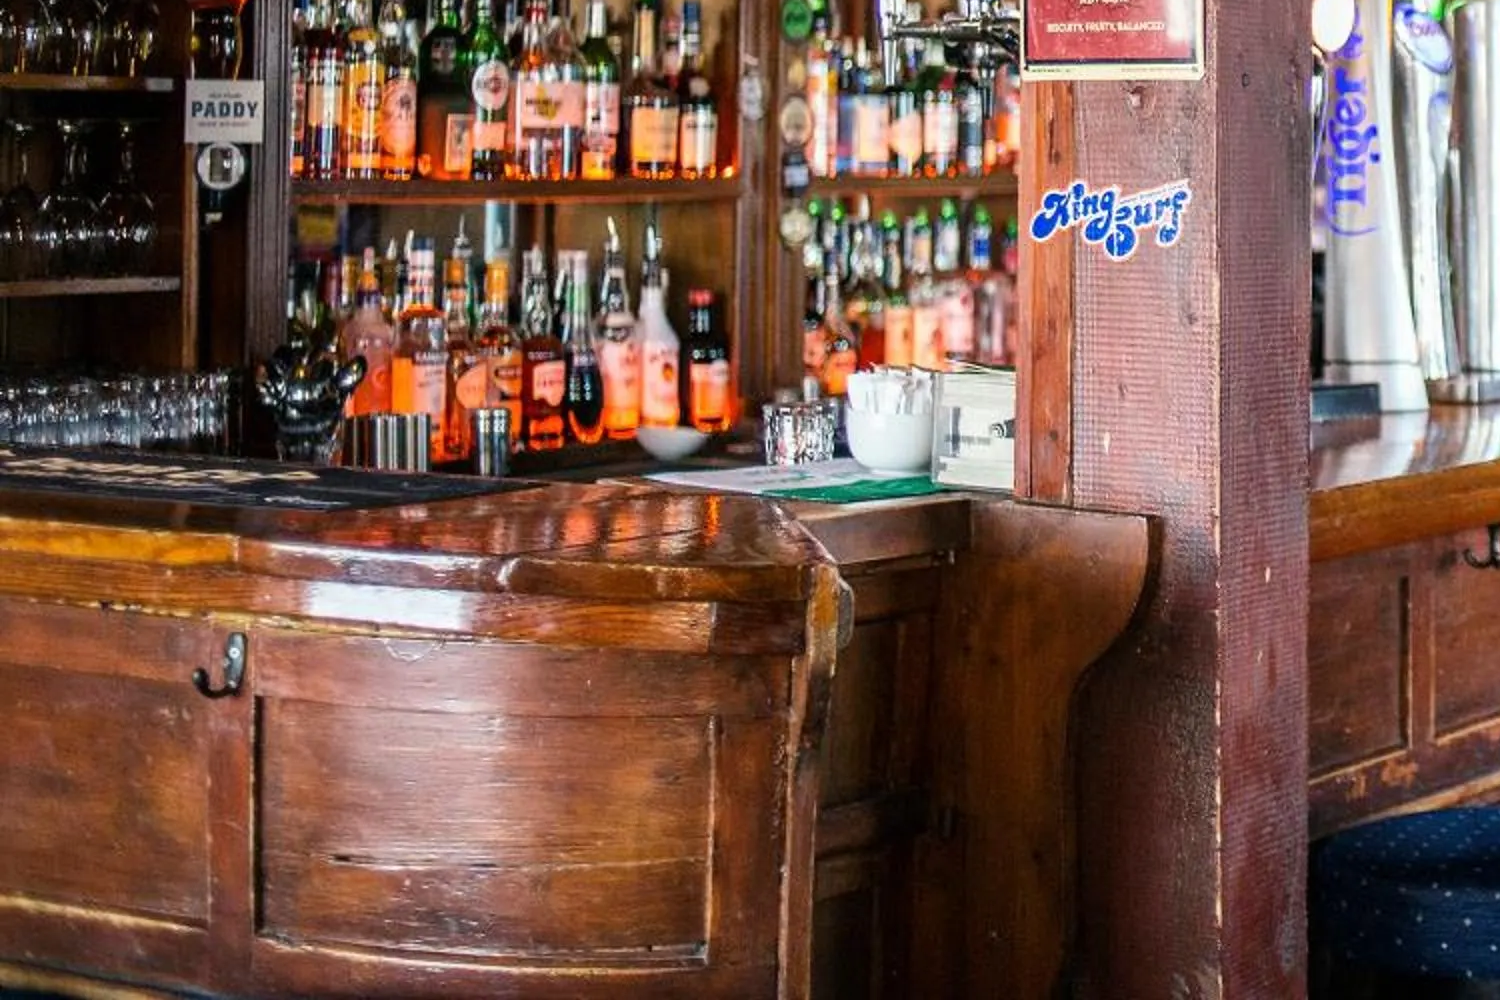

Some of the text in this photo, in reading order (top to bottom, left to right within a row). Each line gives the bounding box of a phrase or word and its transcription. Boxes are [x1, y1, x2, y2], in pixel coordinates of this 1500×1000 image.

[1117, 20, 1166, 32] BALANCED
[191, 101, 259, 118] PADDY
[1325, 67, 1381, 218] Tiger
